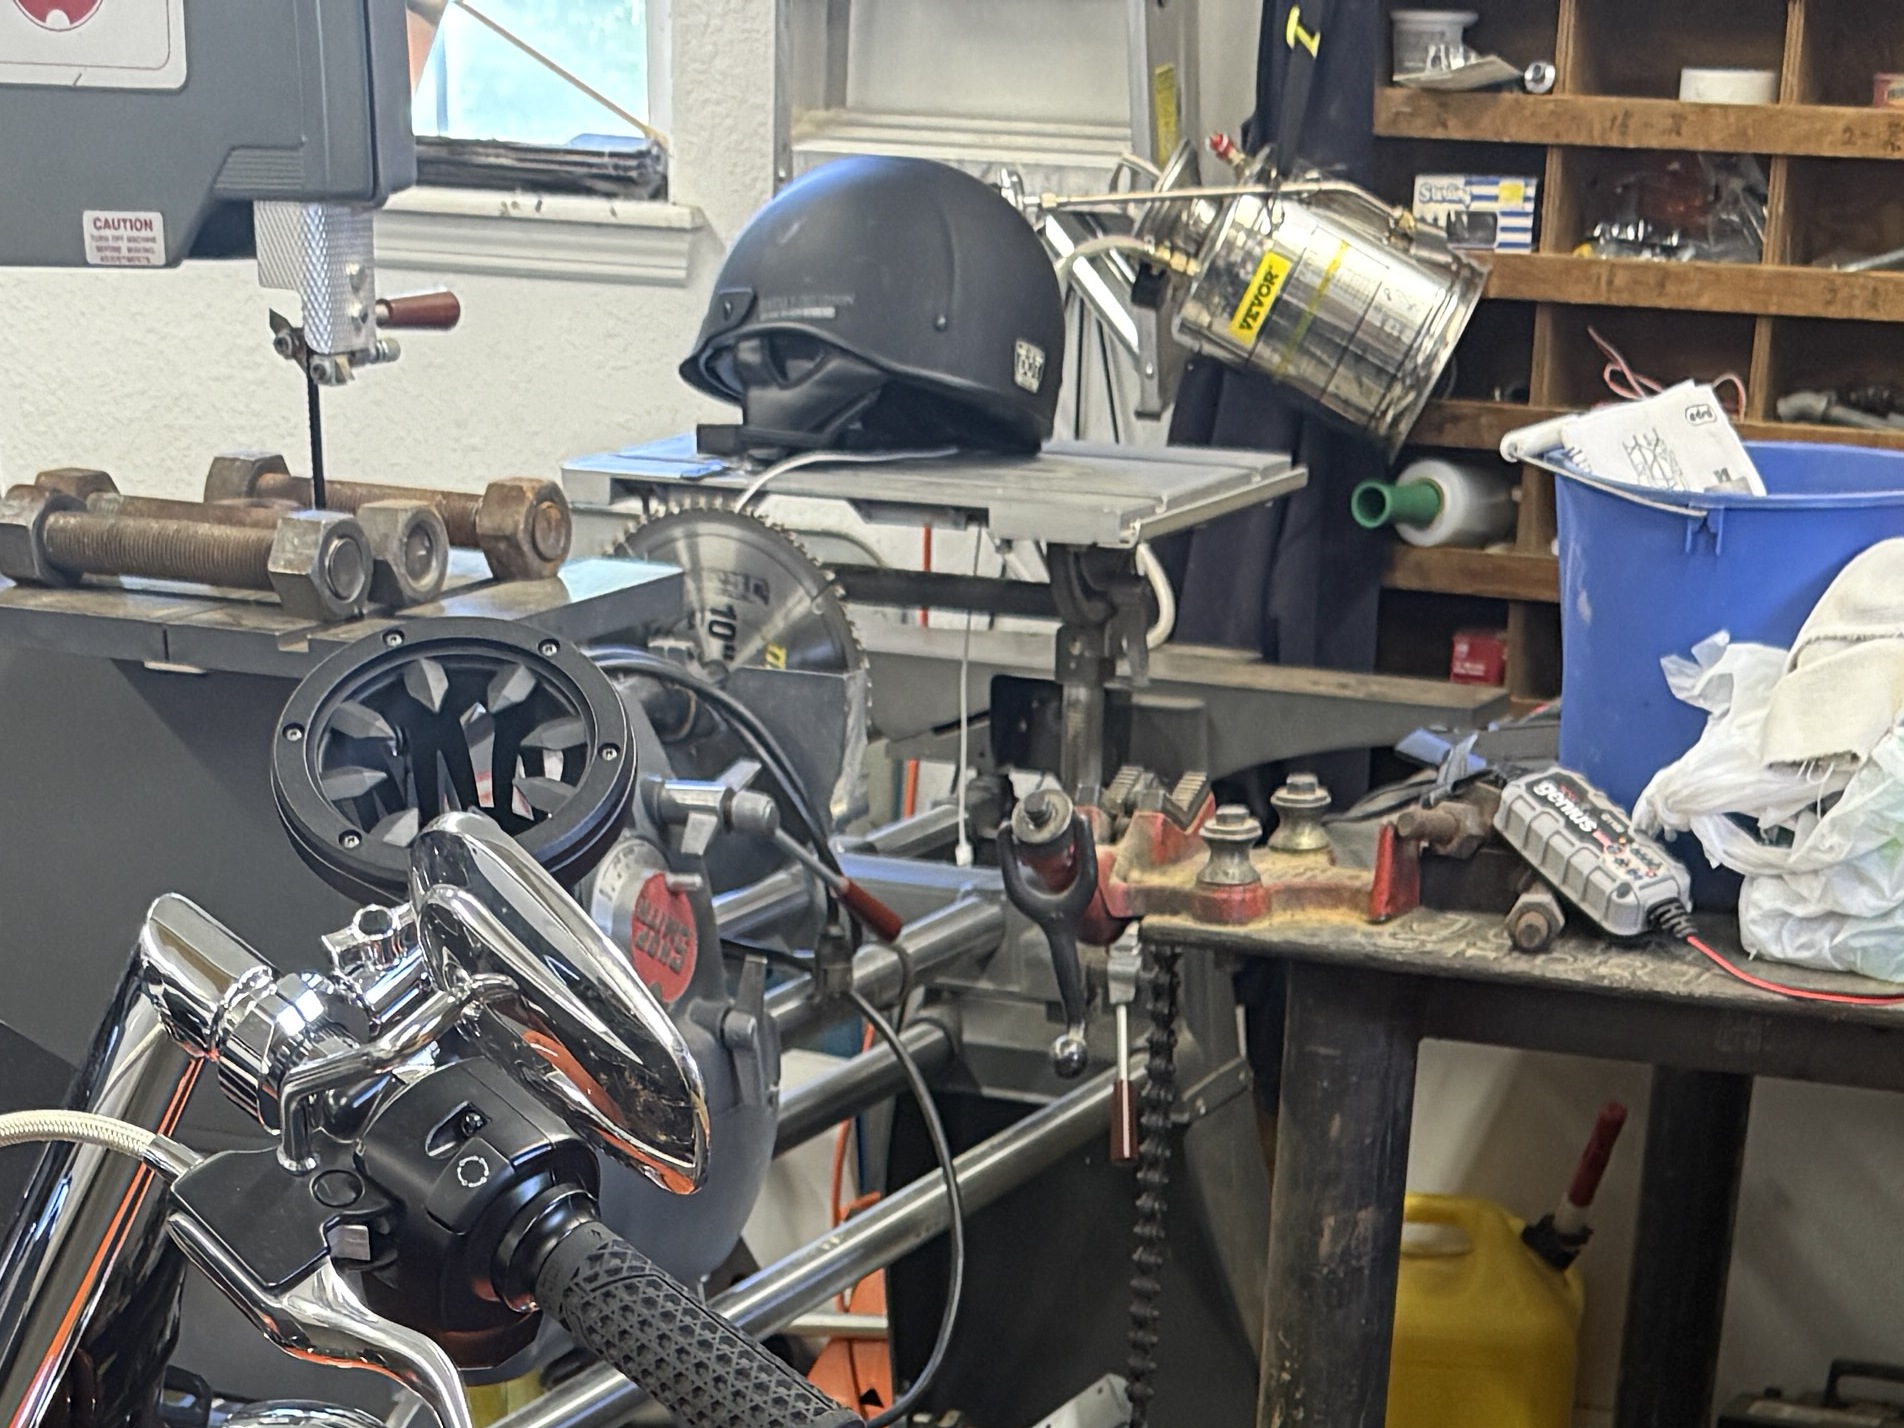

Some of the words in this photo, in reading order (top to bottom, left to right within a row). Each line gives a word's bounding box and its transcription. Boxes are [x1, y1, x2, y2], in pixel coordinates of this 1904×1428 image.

[92, 216, 153, 232] CAUTION
[1239, 267, 1279, 332] VEVOR
[1533, 779, 1598, 833] genius
